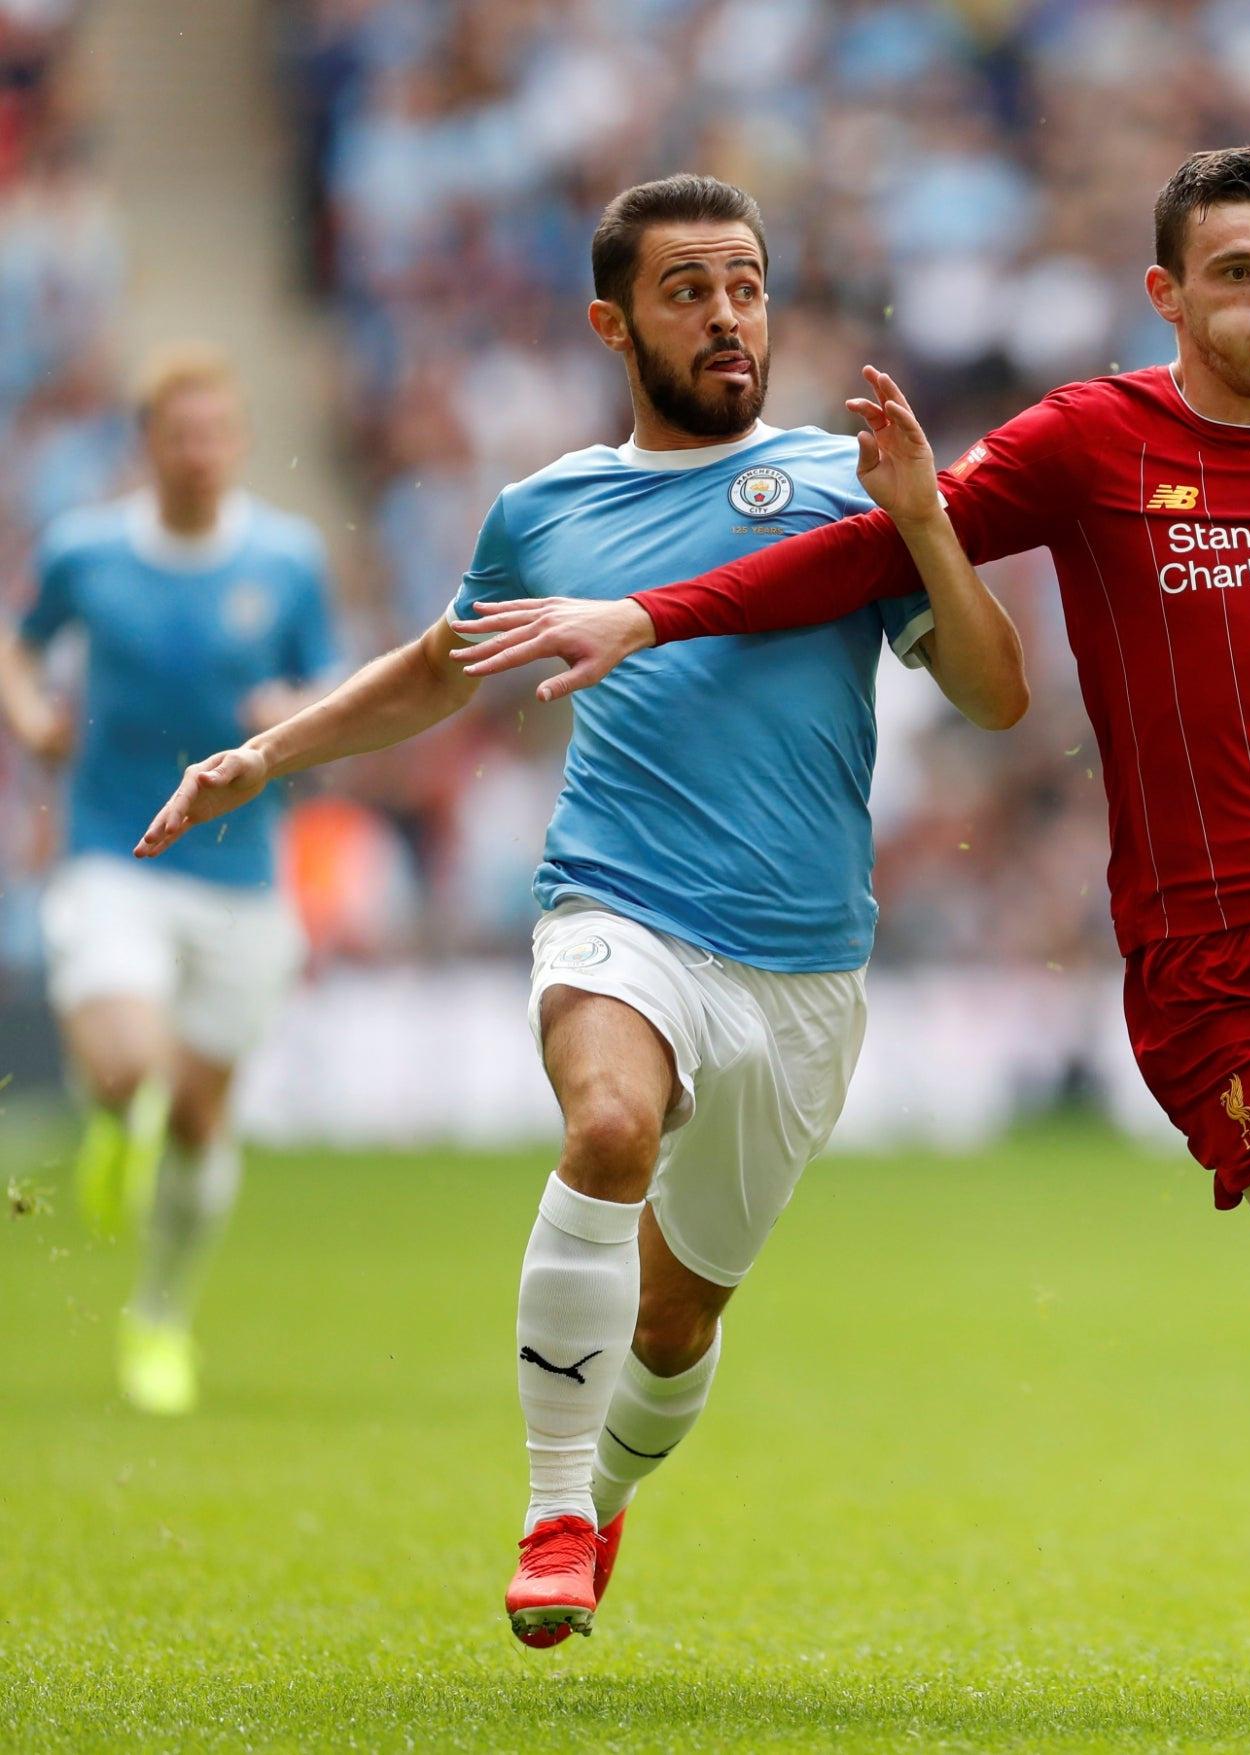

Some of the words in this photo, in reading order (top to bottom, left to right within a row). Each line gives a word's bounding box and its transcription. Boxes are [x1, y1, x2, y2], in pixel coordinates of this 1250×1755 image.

[736, 468, 787, 486] MANCHESTER
[749, 506, 768, 514] CITY
[751, 526, 785, 536] YEARS
